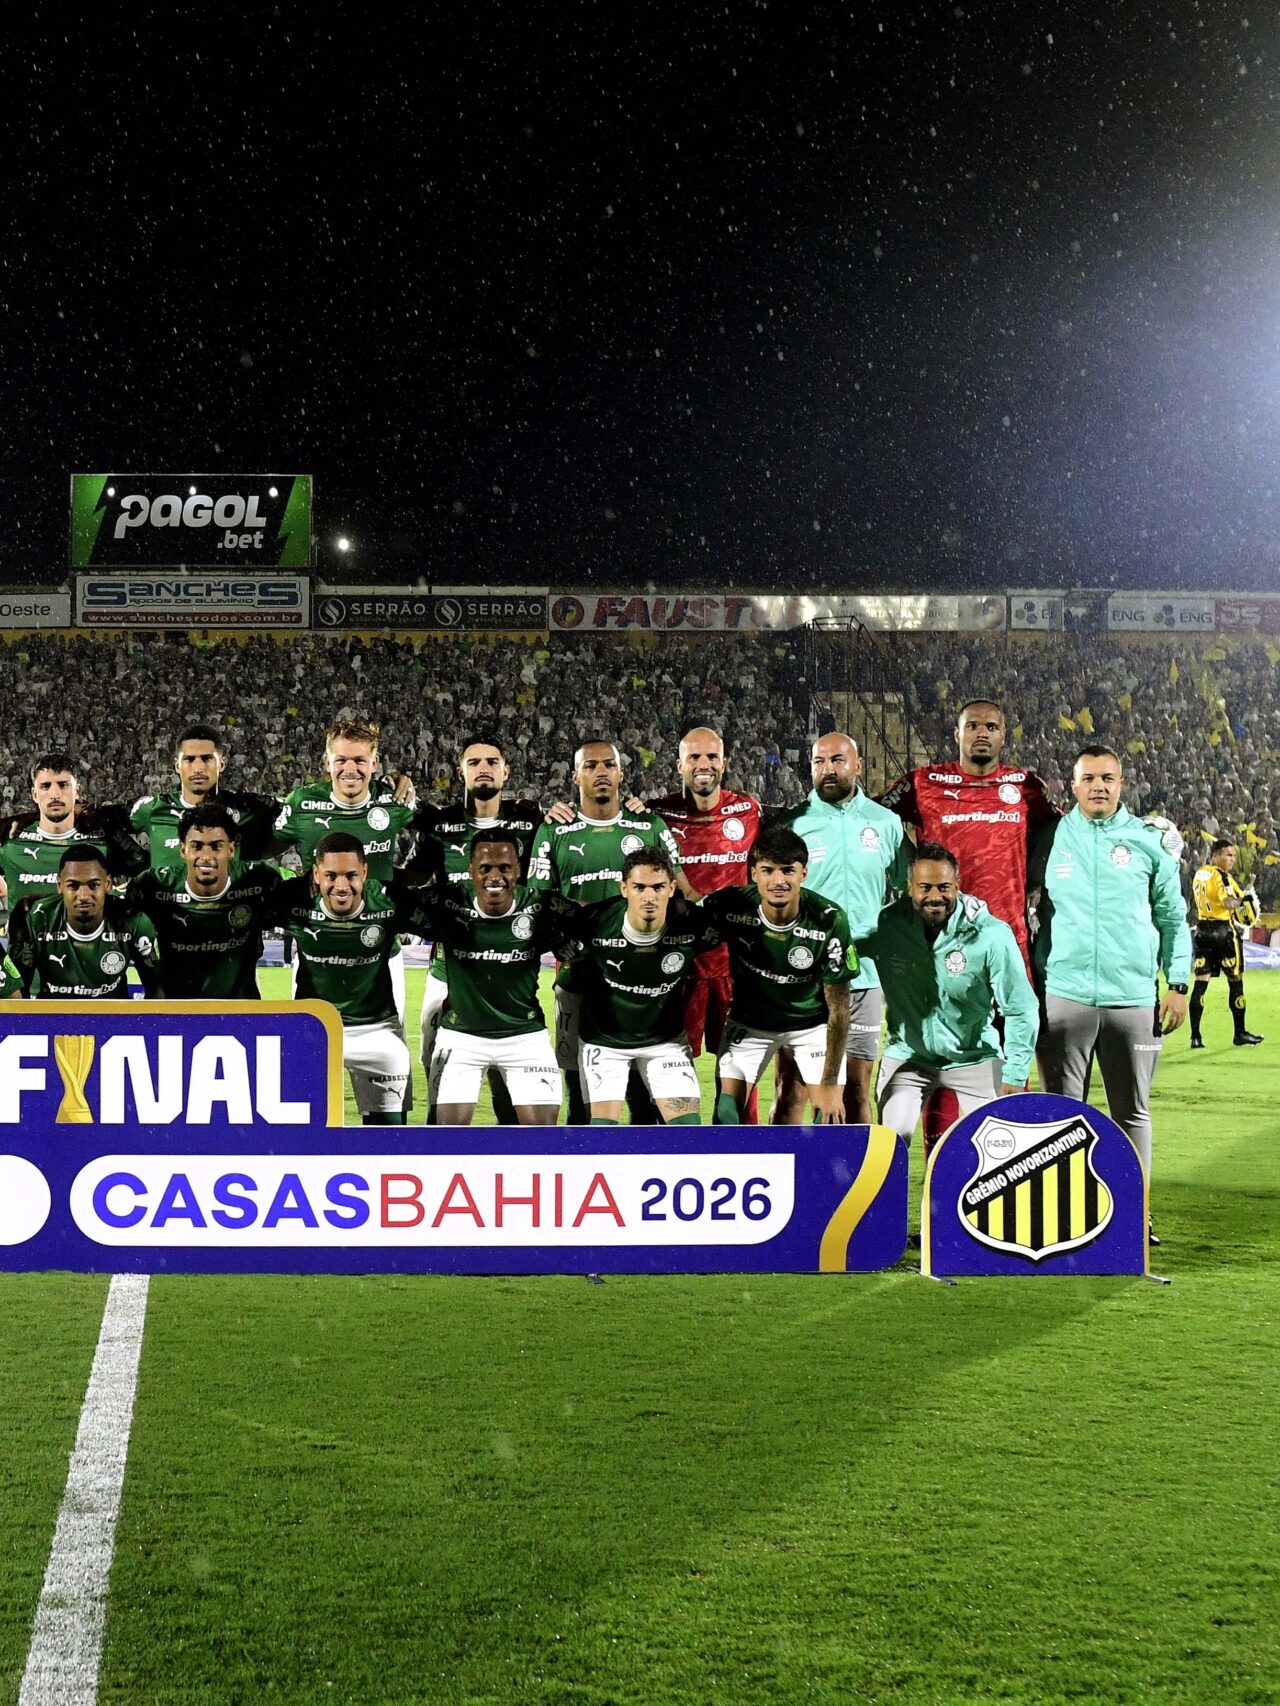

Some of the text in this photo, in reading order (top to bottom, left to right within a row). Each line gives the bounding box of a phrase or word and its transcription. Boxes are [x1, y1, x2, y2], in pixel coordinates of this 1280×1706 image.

[217, 530, 264, 549] .bet
[0, 604, 51, 617] Oeste
[351, 601, 426, 615] SERRÃO
[468, 601, 542, 615] SERRÃO
[87, 613, 298, 623] www.sanchesrodos.com.br
[1112, 610, 1145, 622] ENG
[1179, 611, 1212, 624] ENG
[929, 773, 963, 784] CIMED
[301, 801, 335, 810] CIMED
[721, 802, 752, 815] CIMED
[942, 810, 1021, 824] sportingbet
[555, 822, 587, 835] CIMED
[619, 821, 652, 830] CIMED
[19, 831, 44, 842] IMED
[678, 851, 749, 865] portingbet
[155, 891, 191, 903] CIMED
[291, 907, 326, 921] CIMED
[360, 909, 395, 921] CIMED
[726, 914, 761, 927] CIMED
[662, 935, 695, 945] CIMED
[793, 927, 826, 941] CIMED
[592, 938, 627, 948] CIMED
[586, 1047, 601, 1067] 12
[966, 1126, 1087, 1206] GRÊMIO NOVORIZONTINO
[640, 1177, 772, 1222] 2026
